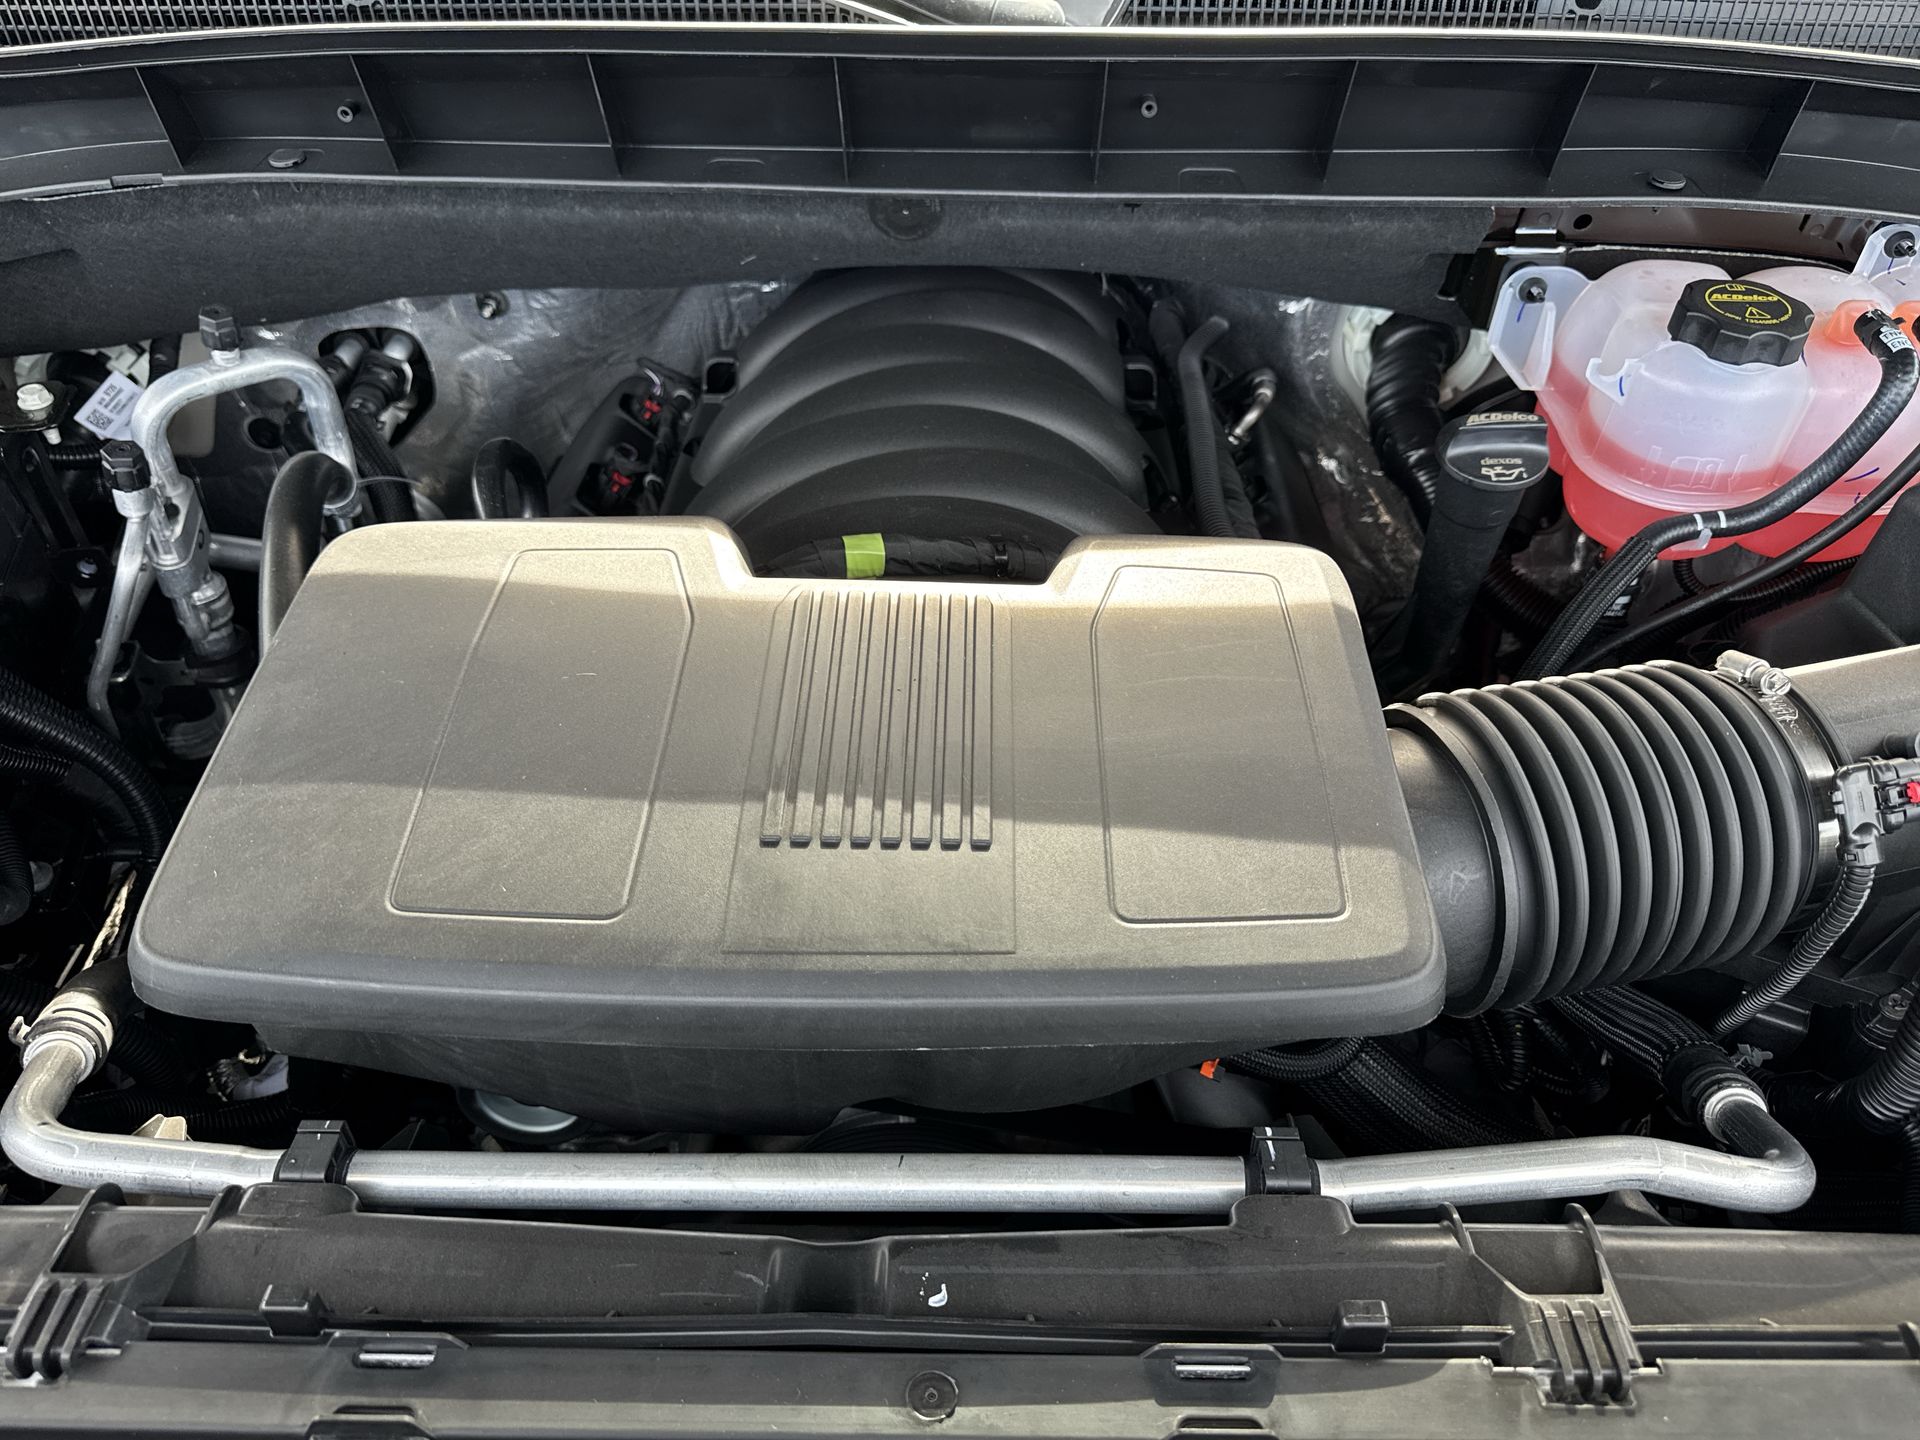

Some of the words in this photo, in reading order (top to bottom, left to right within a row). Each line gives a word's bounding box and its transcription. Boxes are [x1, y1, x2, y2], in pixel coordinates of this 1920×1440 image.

[1710, 293, 1778, 302] ACDelco
[1466, 412, 1539, 426] ACDelco
[1480, 457, 1523, 466] dexos
